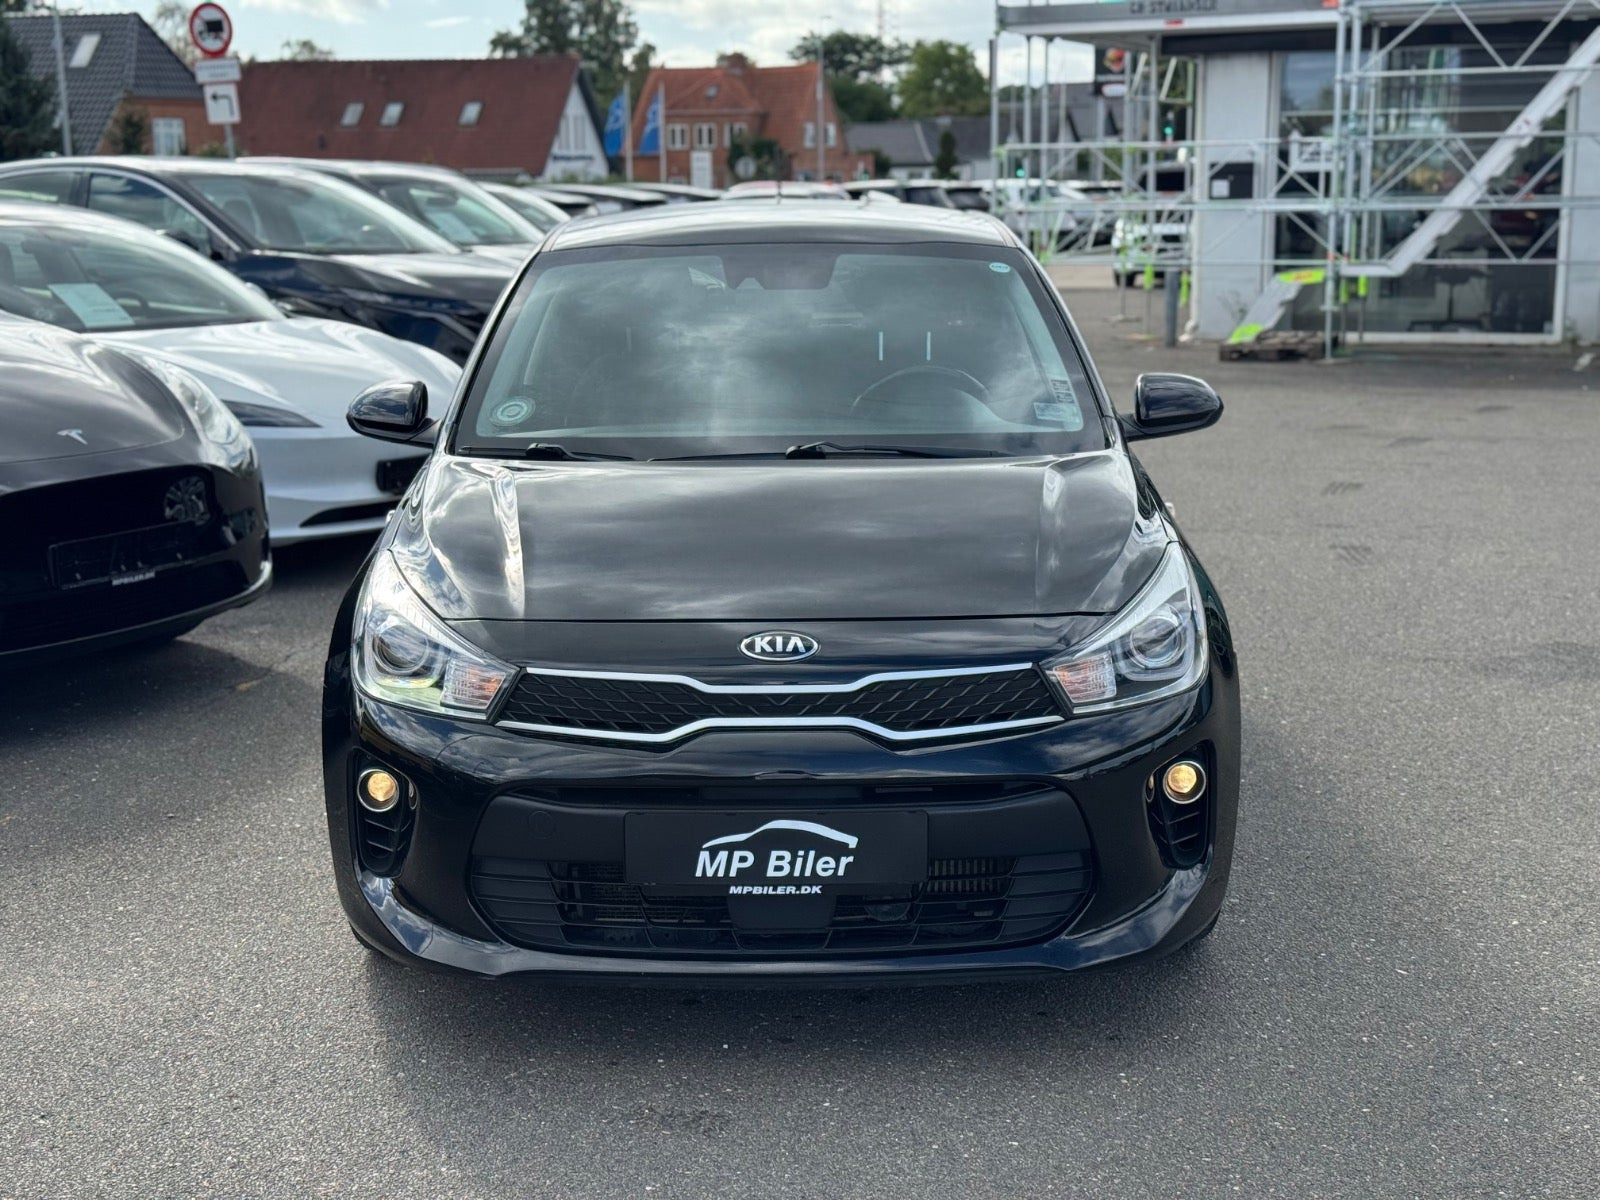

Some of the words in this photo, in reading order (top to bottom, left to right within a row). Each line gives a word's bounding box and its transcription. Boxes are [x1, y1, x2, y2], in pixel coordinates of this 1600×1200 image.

[754, 635, 806, 653] KIA
[695, 850, 755, 878] MP
[766, 850, 854, 878] Biler
[729, 885, 823, 895] MPBILER.DK
